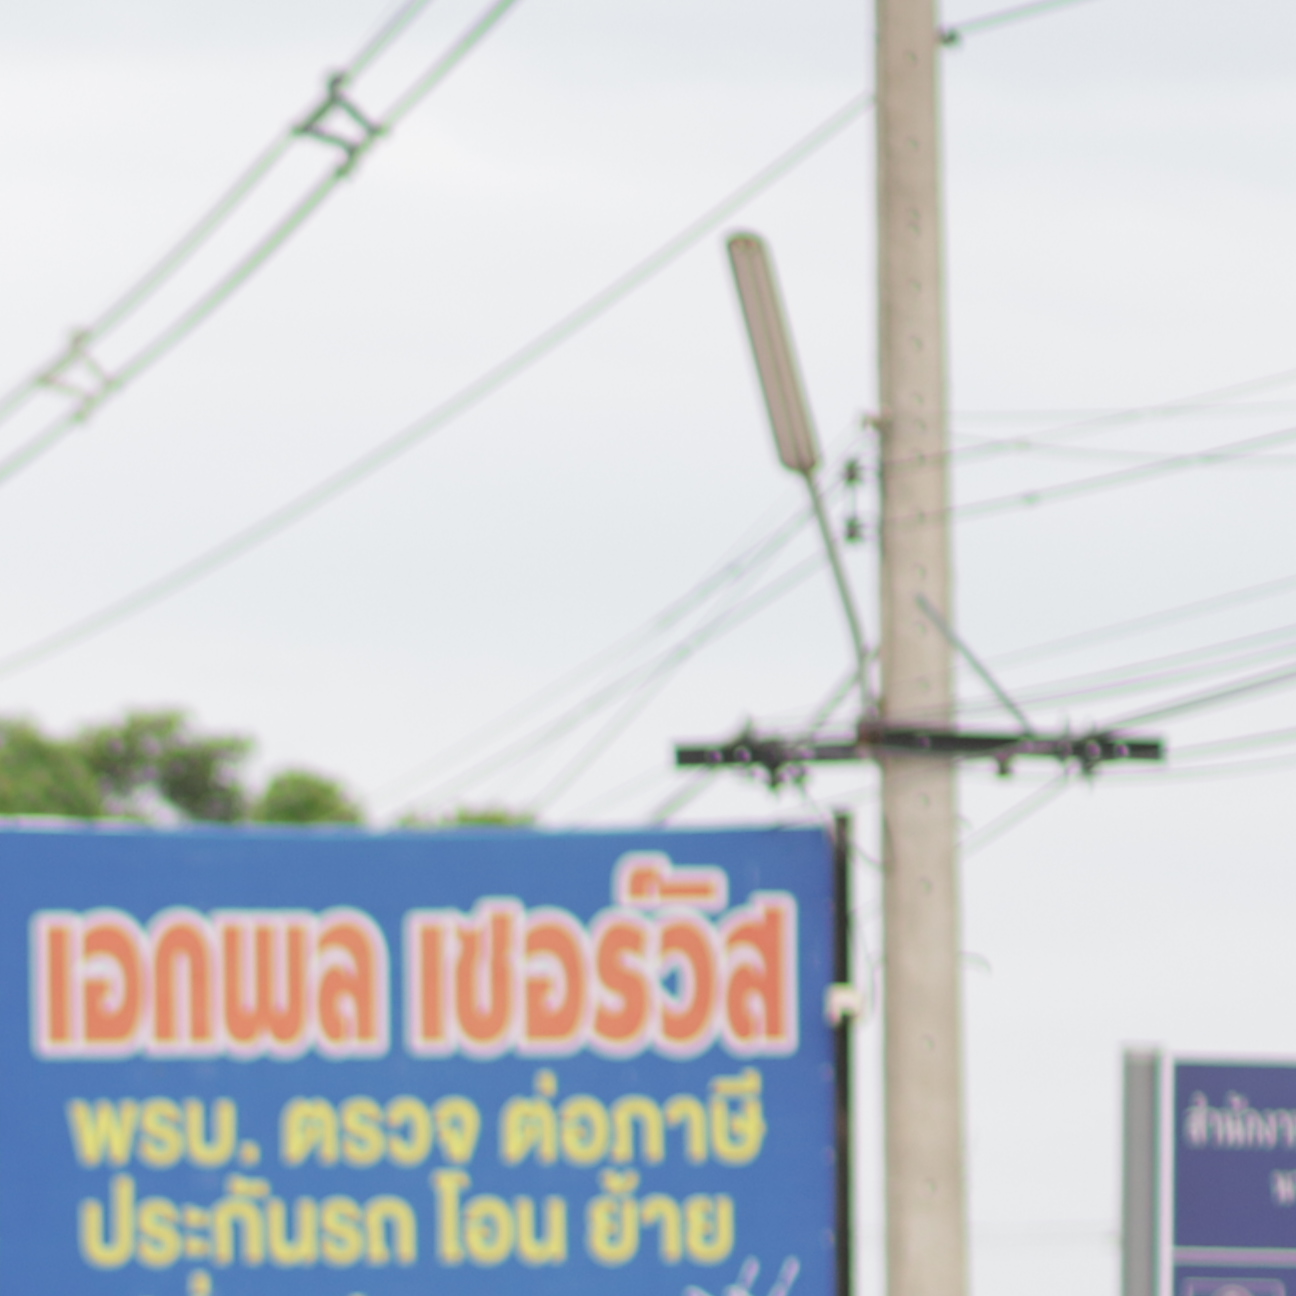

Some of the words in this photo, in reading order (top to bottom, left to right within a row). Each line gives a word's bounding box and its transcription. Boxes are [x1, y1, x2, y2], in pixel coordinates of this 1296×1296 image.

[30, 906, 391, 1059] เอกพล
[68, 1096, 261, 1168] พรบ.
[281, 1094, 481, 1170] ตรวจ
[500, 1068, 767, 1169] ต่อภาษี
[1182, 1089, 1296, 1151] สำนักงา
[78, 1173, 418, 1269] ประกันรถ
[431, 1168, 568, 1267] โอน
[587, 1167, 737, 1267] ย้าย
